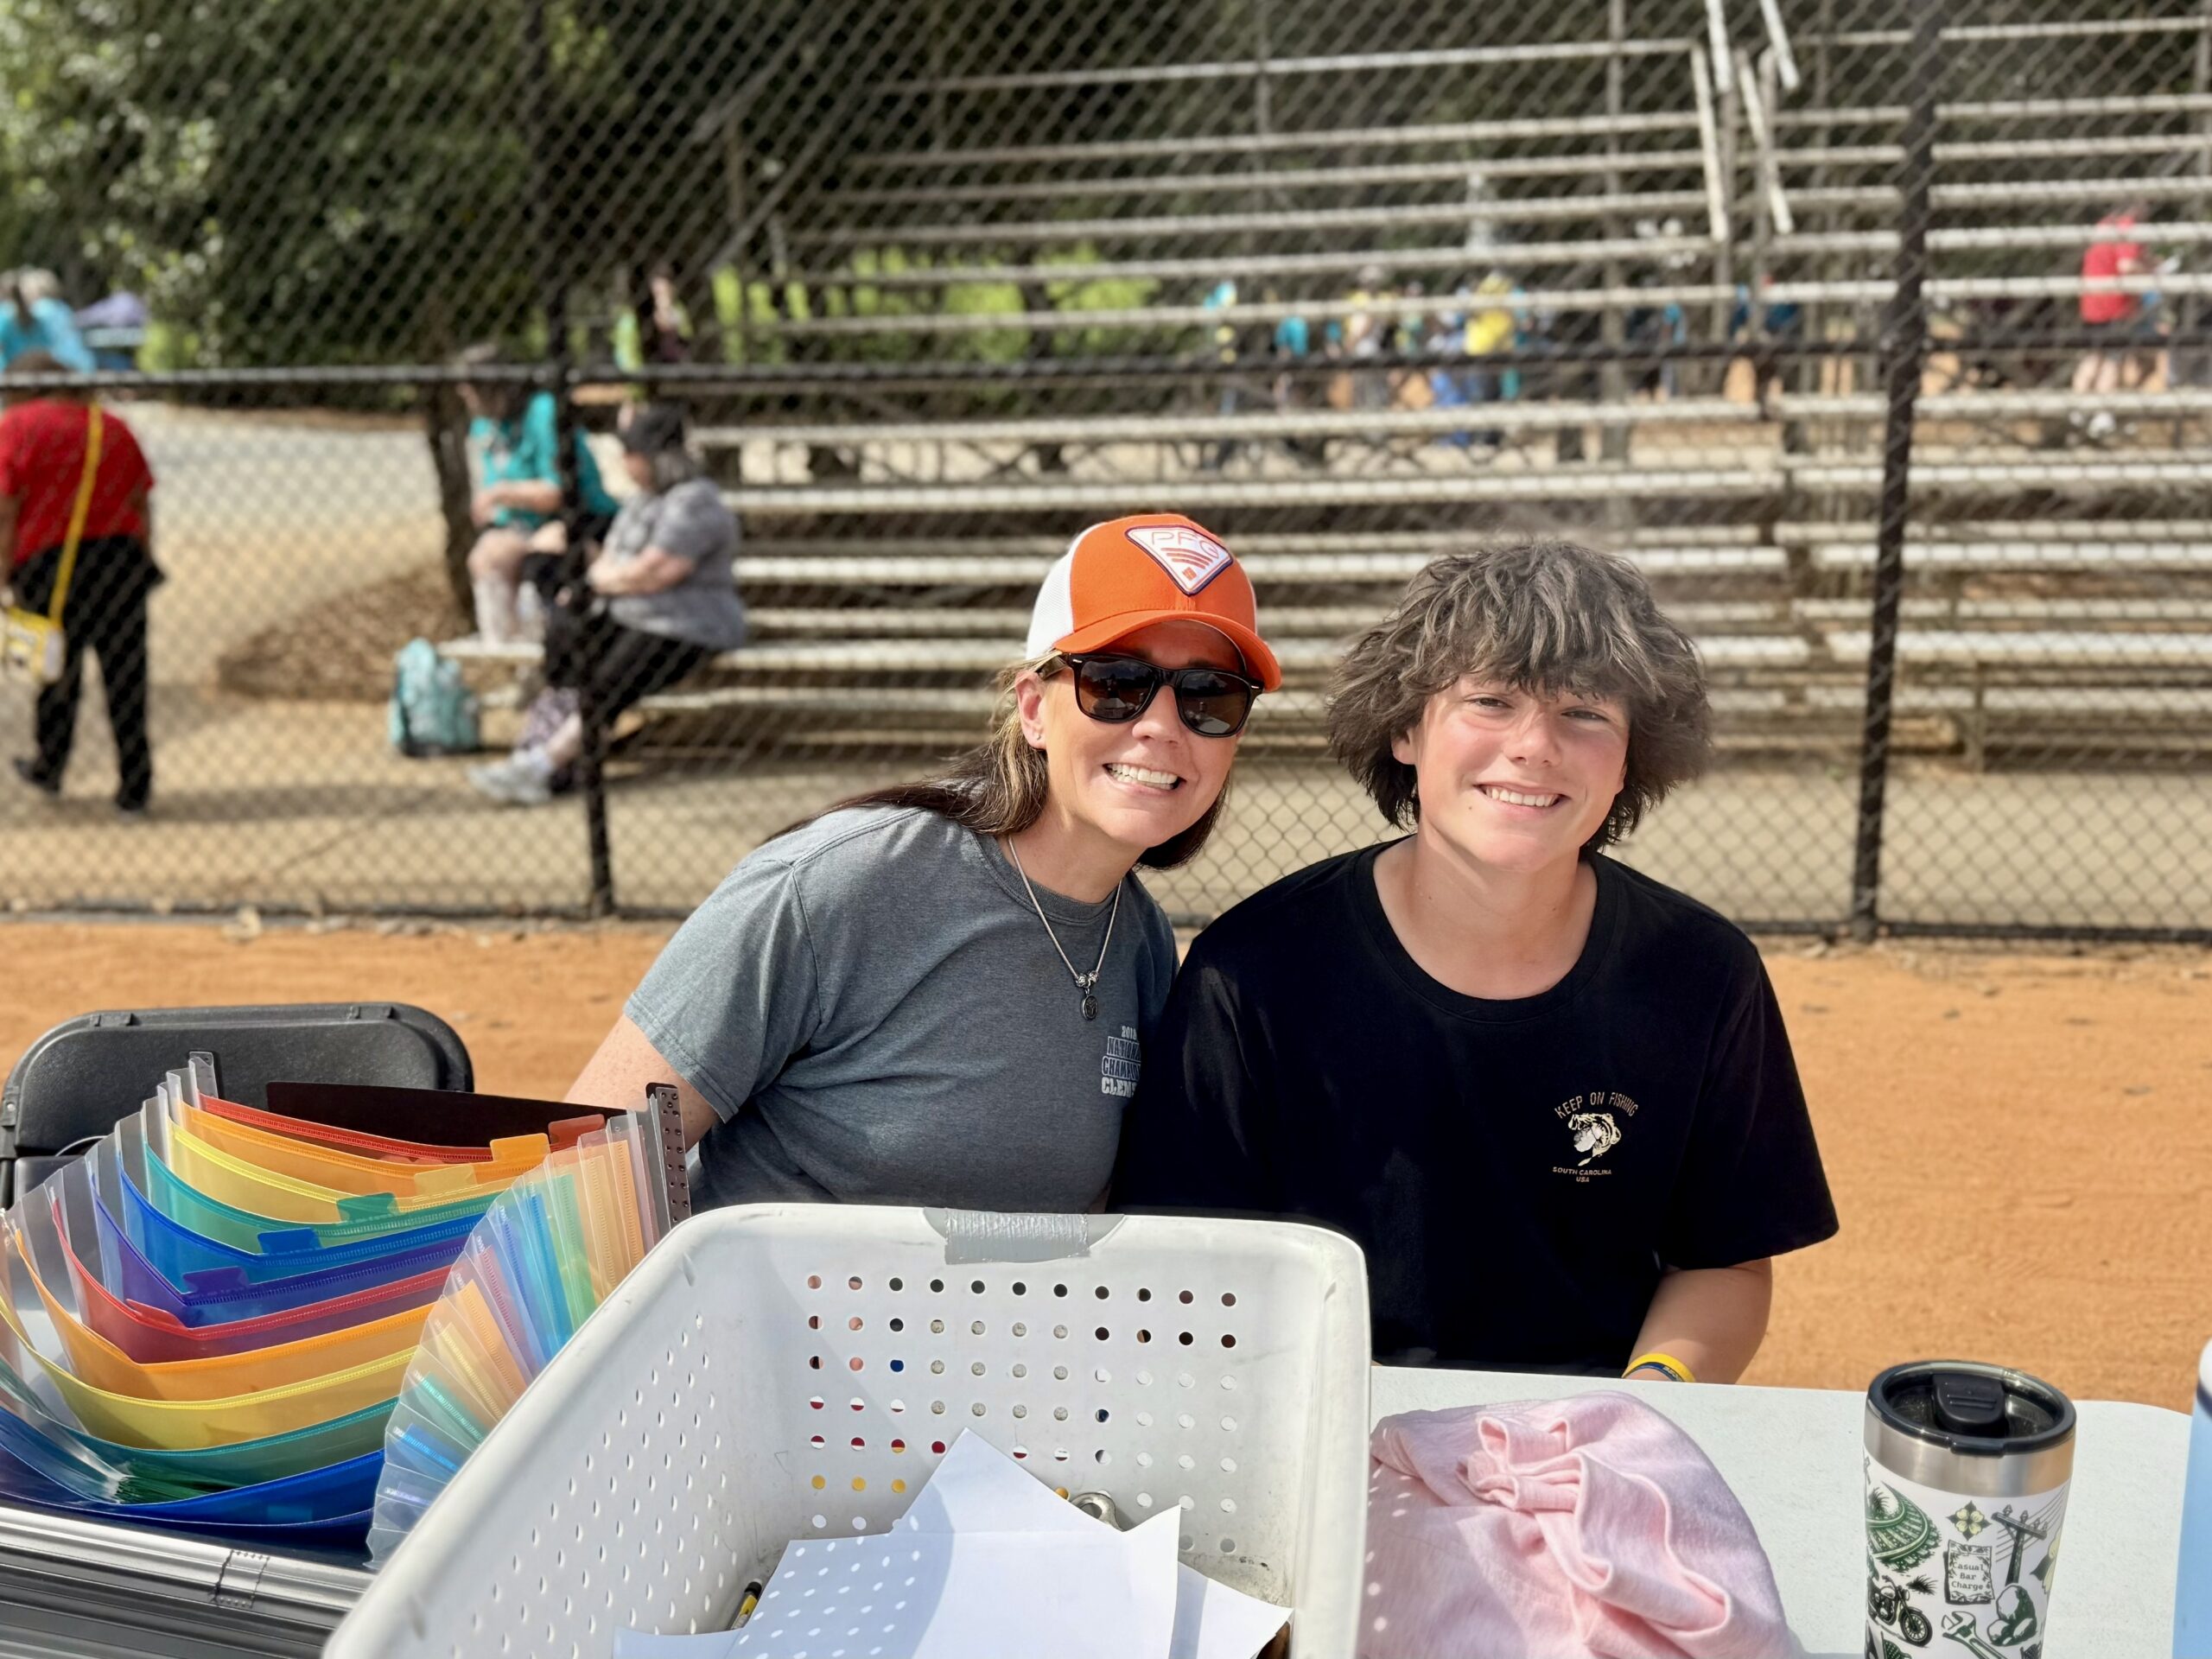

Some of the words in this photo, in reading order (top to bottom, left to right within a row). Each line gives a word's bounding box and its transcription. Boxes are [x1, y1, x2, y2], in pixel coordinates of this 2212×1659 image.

[1151, 531, 1219, 559] PFG
[1554, 1096, 1583, 1119] KEEP
[1590, 1091, 1605, 1105] ON
[1609, 1091, 1638, 1116] FISHING
[1952, 1562, 1984, 1571] Casual
[1951, 1580, 1983, 1591] Charge
